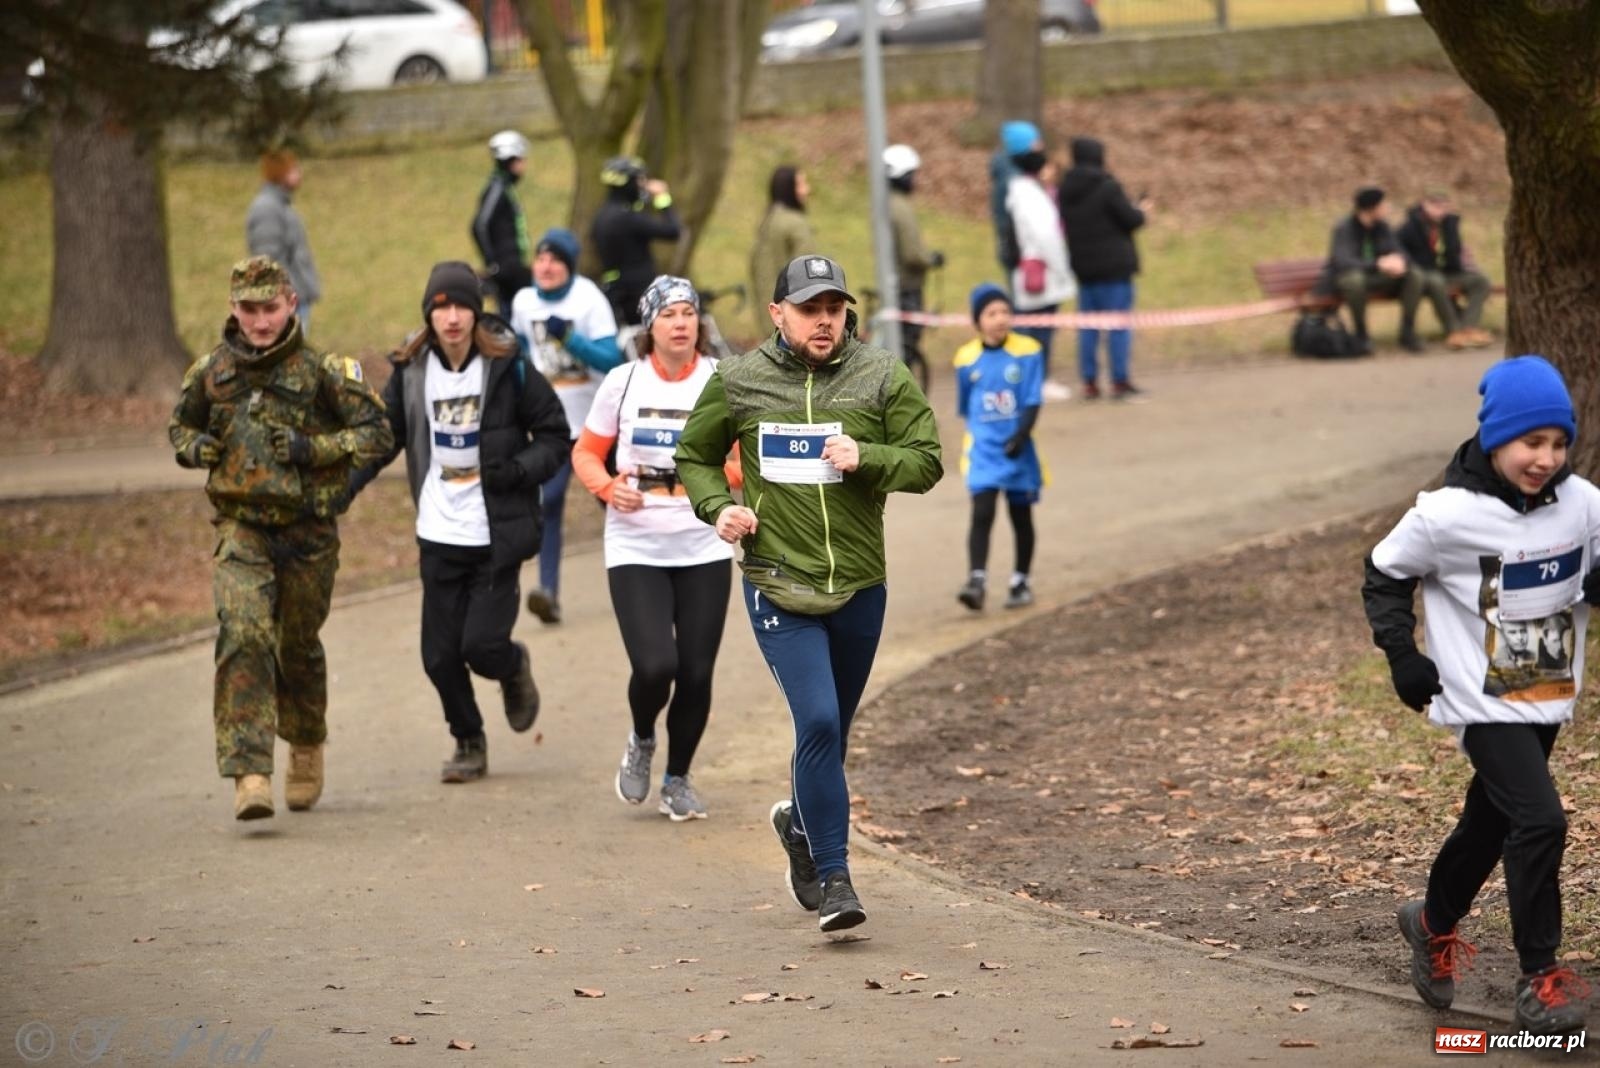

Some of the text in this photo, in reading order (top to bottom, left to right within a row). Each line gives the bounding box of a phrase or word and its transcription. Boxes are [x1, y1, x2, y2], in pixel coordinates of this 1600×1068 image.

[655, 431, 673, 444] 98
[789, 439, 810, 454] 80
[1538, 560, 1560, 580] 79
